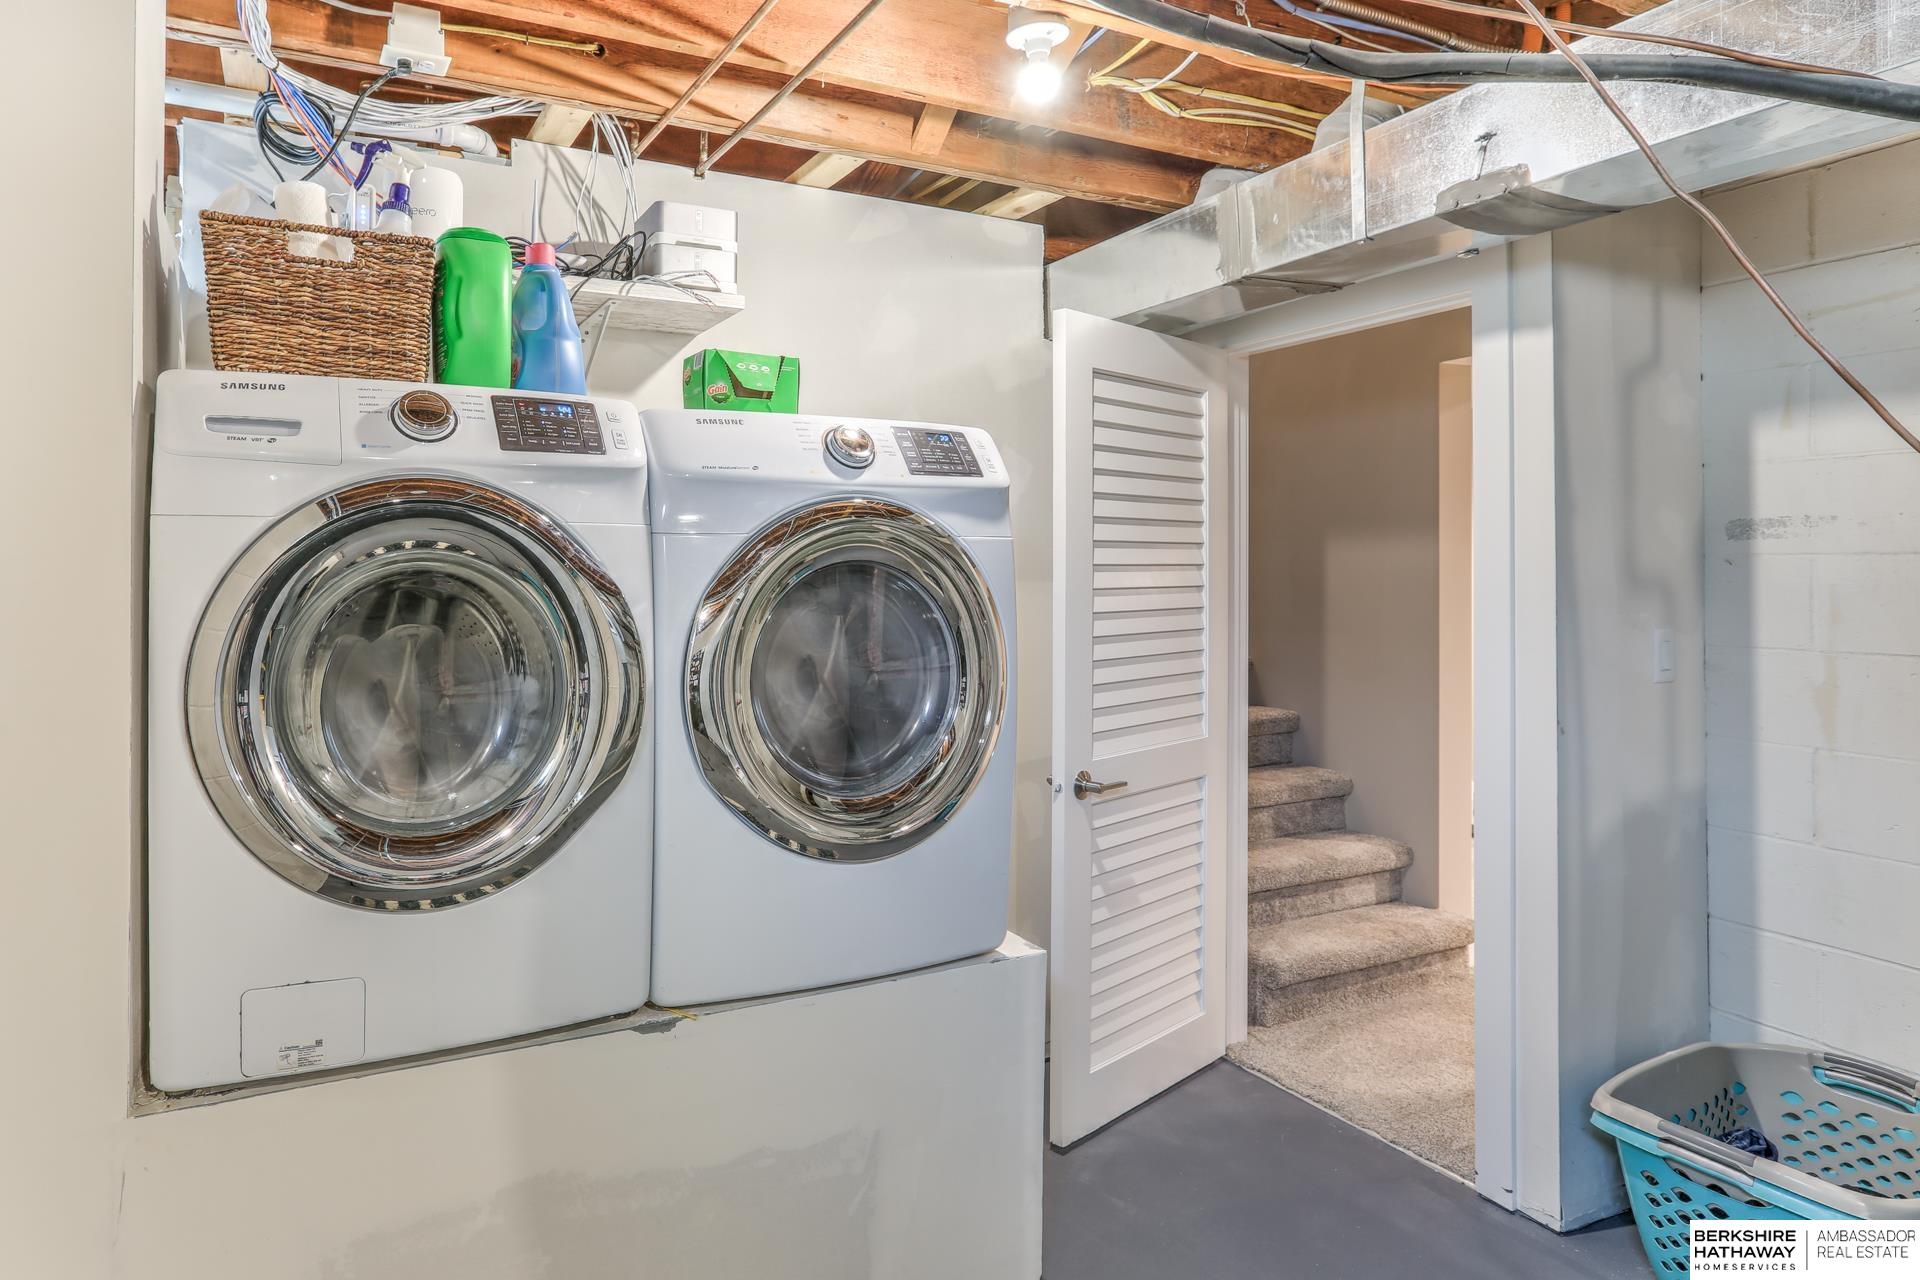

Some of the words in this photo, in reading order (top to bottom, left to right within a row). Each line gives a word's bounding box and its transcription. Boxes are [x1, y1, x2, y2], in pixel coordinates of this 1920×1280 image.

[411, 207, 437, 217] eero
[220, 382, 286, 391] SAMSUNG
[707, 384, 728, 396] Gain
[696, 418, 744, 426] SAMSUNG
